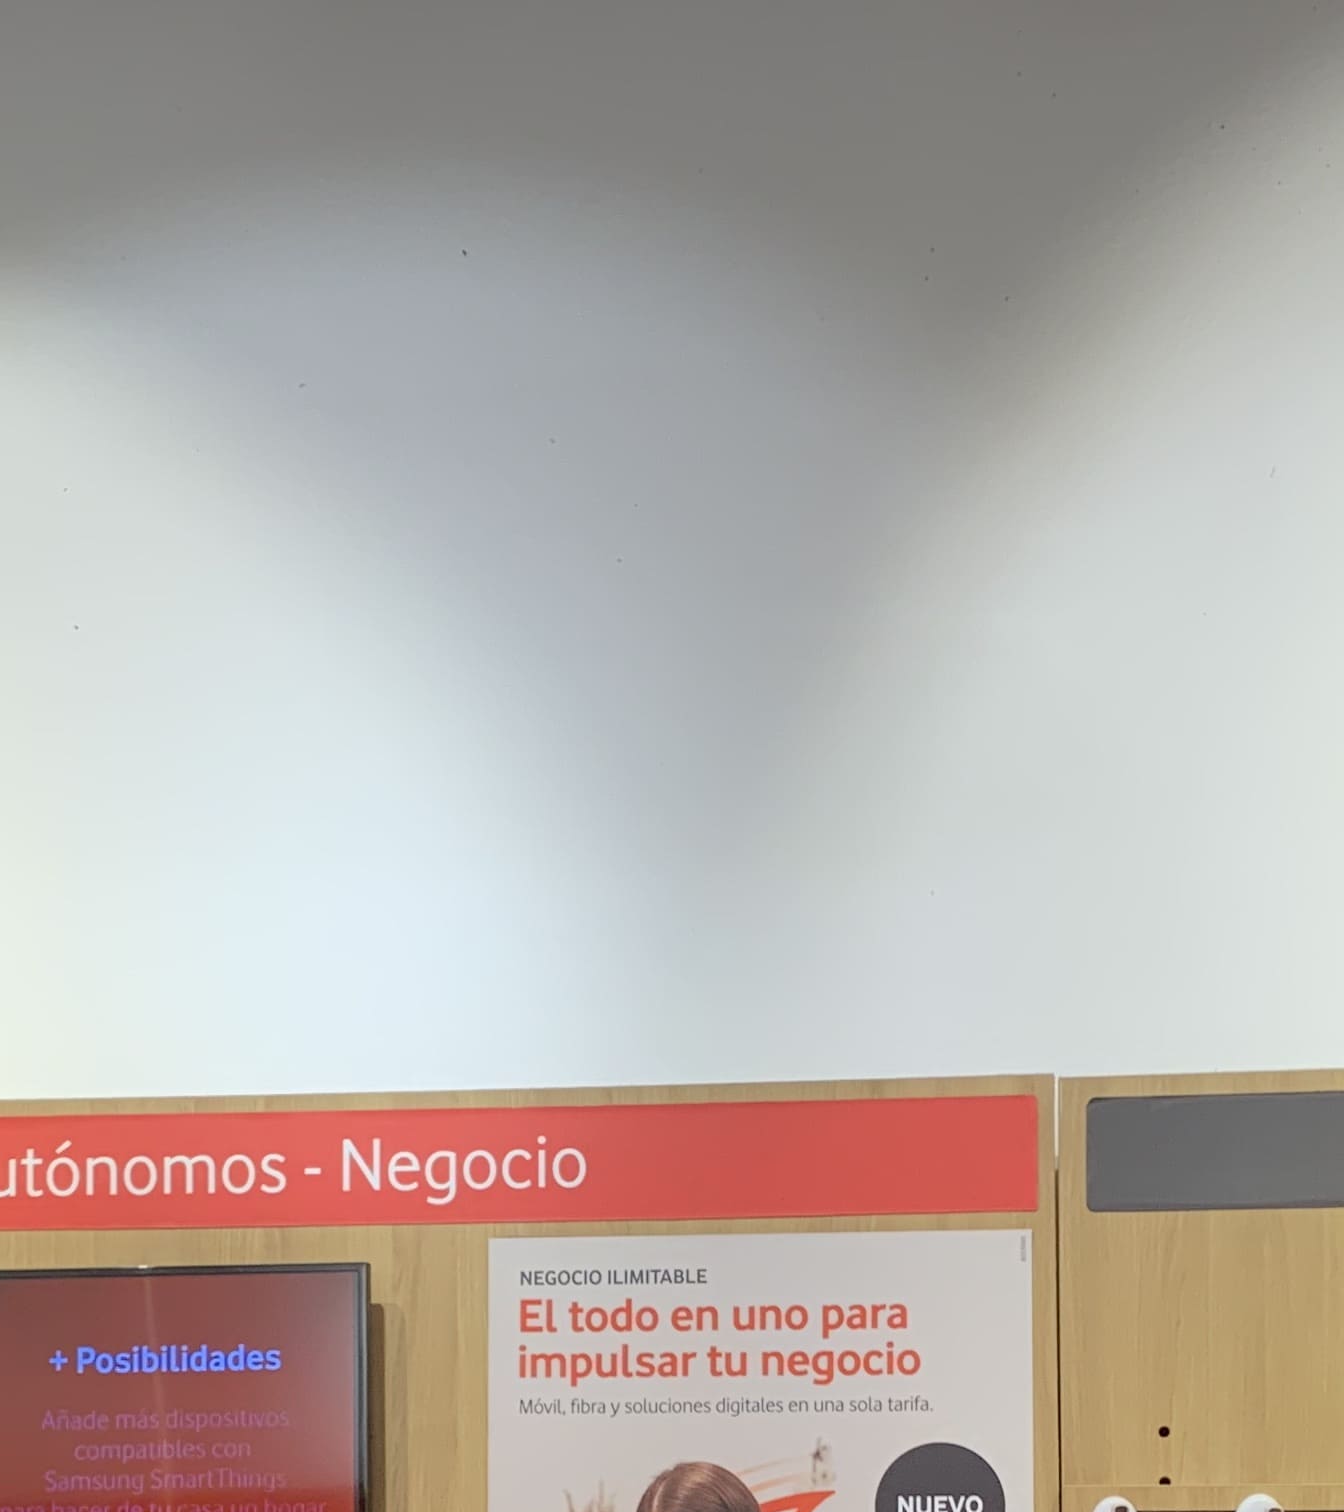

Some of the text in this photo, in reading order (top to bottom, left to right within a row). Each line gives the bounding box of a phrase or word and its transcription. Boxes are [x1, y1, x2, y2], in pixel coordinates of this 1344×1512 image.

[343, 1136, 586, 1205] Negocio
[520, 1269, 707, 1285] NEGOCIO ILIMITABLE
[520, 1298, 907, 1338] El todo en uno para
[77, 1344, 281, 1373] Posibilidades
[519, 1341, 920, 1387] impulsar tu negocio
[42, 1406, 292, 1432] Añade más dispositivos
[520, 1395, 933, 1417] Móvil, fibra y soluciones digitales en una sola tarifa.
[74, 1438, 251, 1464] compatibles con
[45, 1466, 288, 1495] Samsung SmartThings
